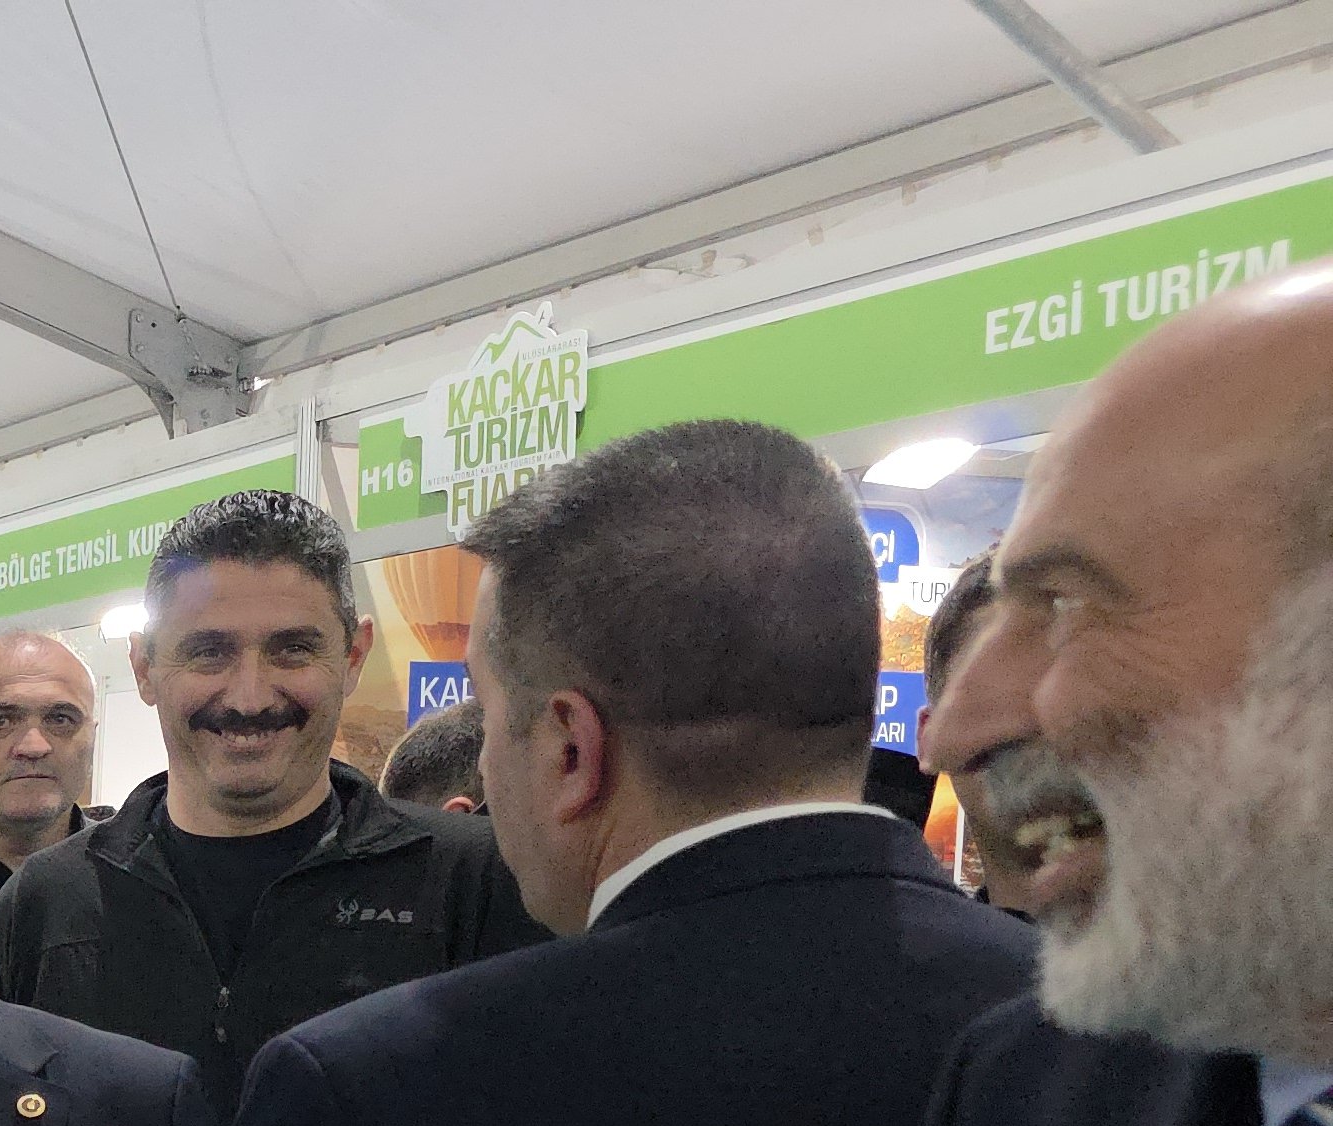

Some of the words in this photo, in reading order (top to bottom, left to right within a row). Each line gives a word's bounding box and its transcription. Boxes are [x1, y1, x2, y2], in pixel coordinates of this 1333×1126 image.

[984, 279, 1084, 356] EZGİ
[444, 400, 570, 472] TURİZM
[361, 458, 414, 497] H16
[451, 463, 546, 527] FUAR
[56, 528, 122, 576] TEMSİL
